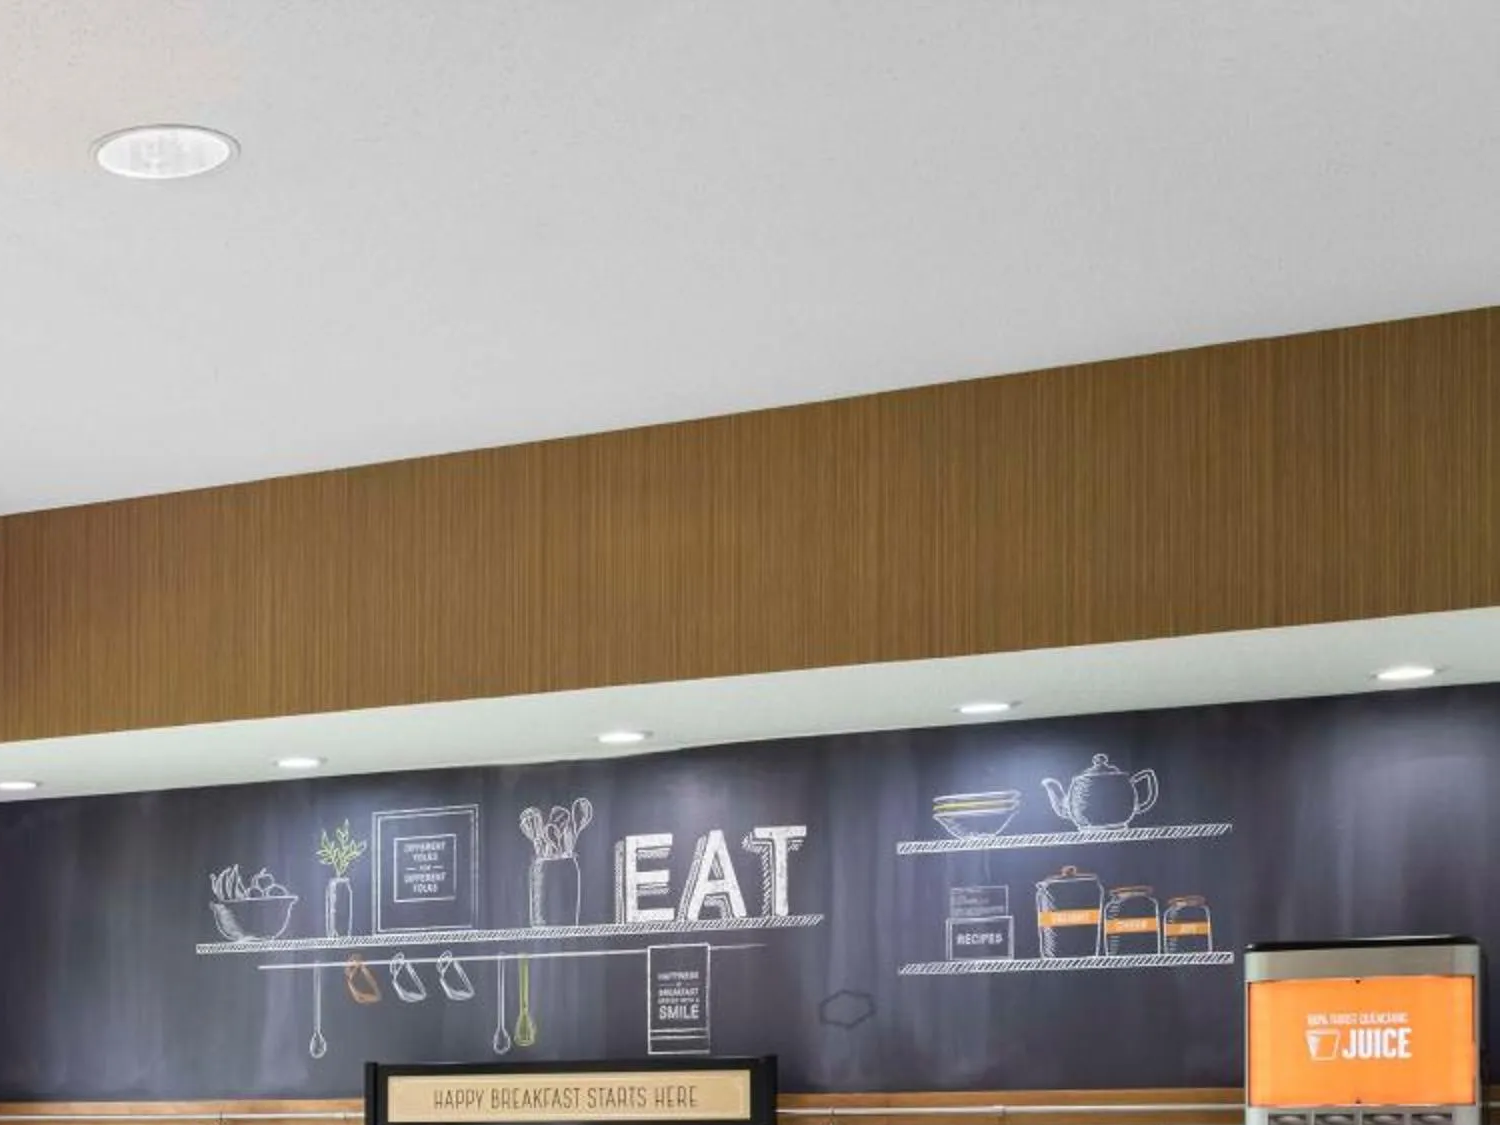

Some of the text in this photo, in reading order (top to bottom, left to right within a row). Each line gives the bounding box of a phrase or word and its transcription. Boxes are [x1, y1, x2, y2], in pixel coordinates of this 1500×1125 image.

[614, 825, 807, 924] EAT
[660, 1004, 699, 1020] SMILE
[1342, 1027, 1412, 1059] JUICE
[433, 1085, 698, 1110] HAPPY BREAKFAST STARTS HERE
